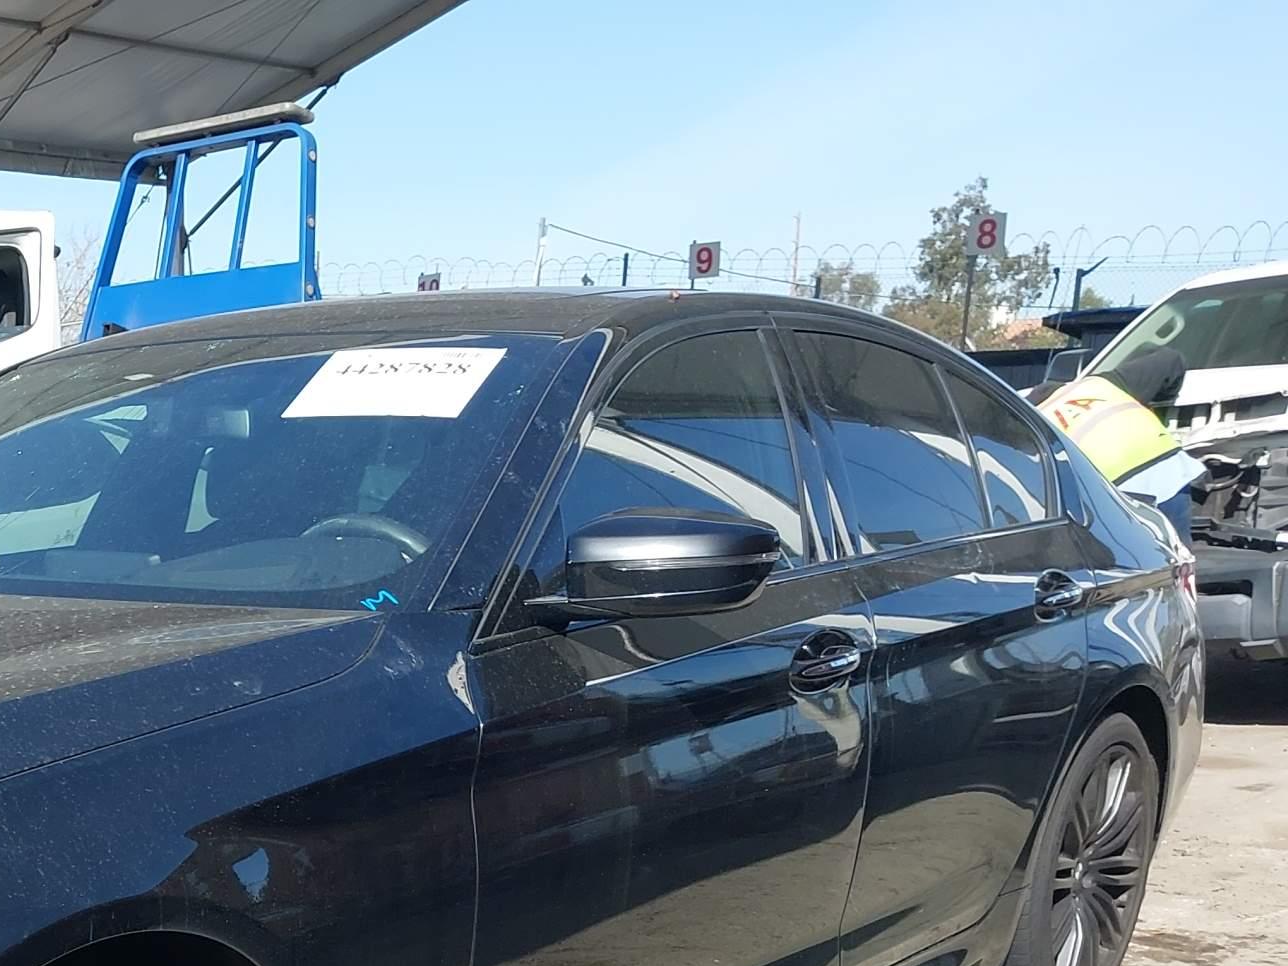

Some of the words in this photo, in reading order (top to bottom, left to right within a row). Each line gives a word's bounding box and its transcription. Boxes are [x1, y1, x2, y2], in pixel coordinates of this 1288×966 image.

[977, 218, 997, 249] 8
[696, 246, 712, 274] 9
[336, 362, 472, 376] 44287828
